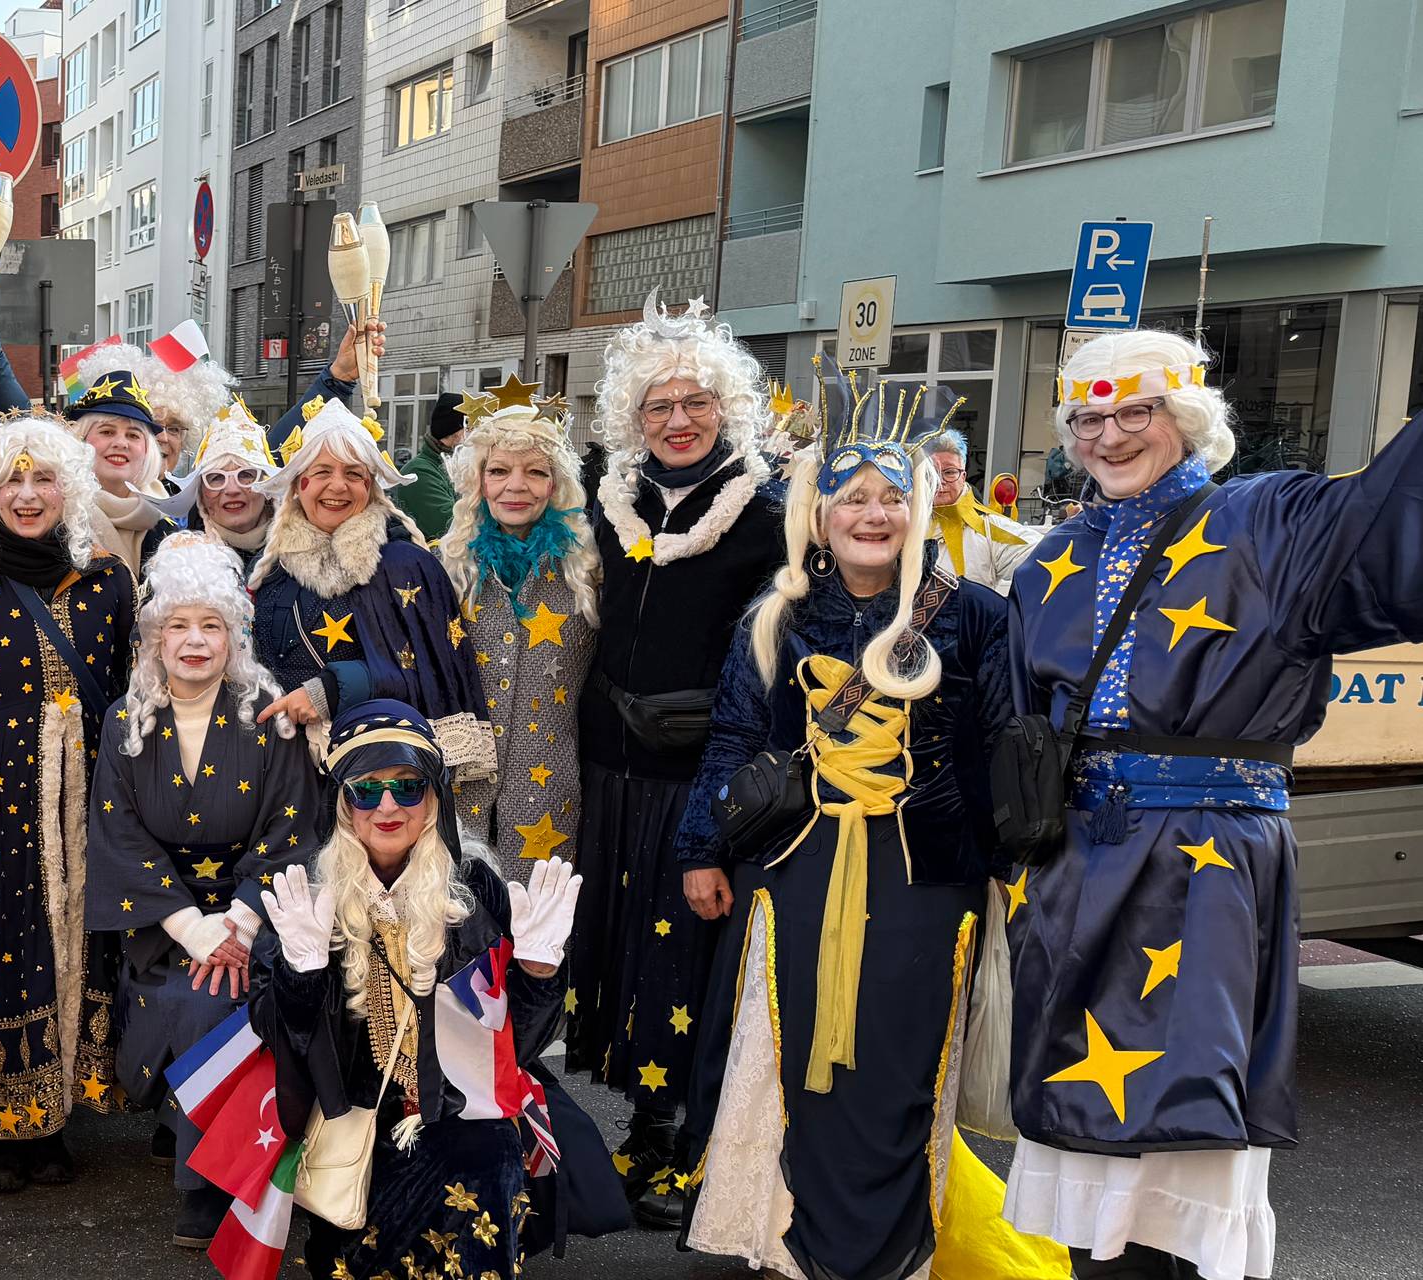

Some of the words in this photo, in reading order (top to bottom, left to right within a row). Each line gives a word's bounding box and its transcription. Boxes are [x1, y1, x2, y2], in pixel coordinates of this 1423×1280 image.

[305, 170, 339, 186] Veledastr.
[1087, 229, 1120, 270] P
[855, 300, 877, 328] 30
[848, 346, 876, 362] ZONE
